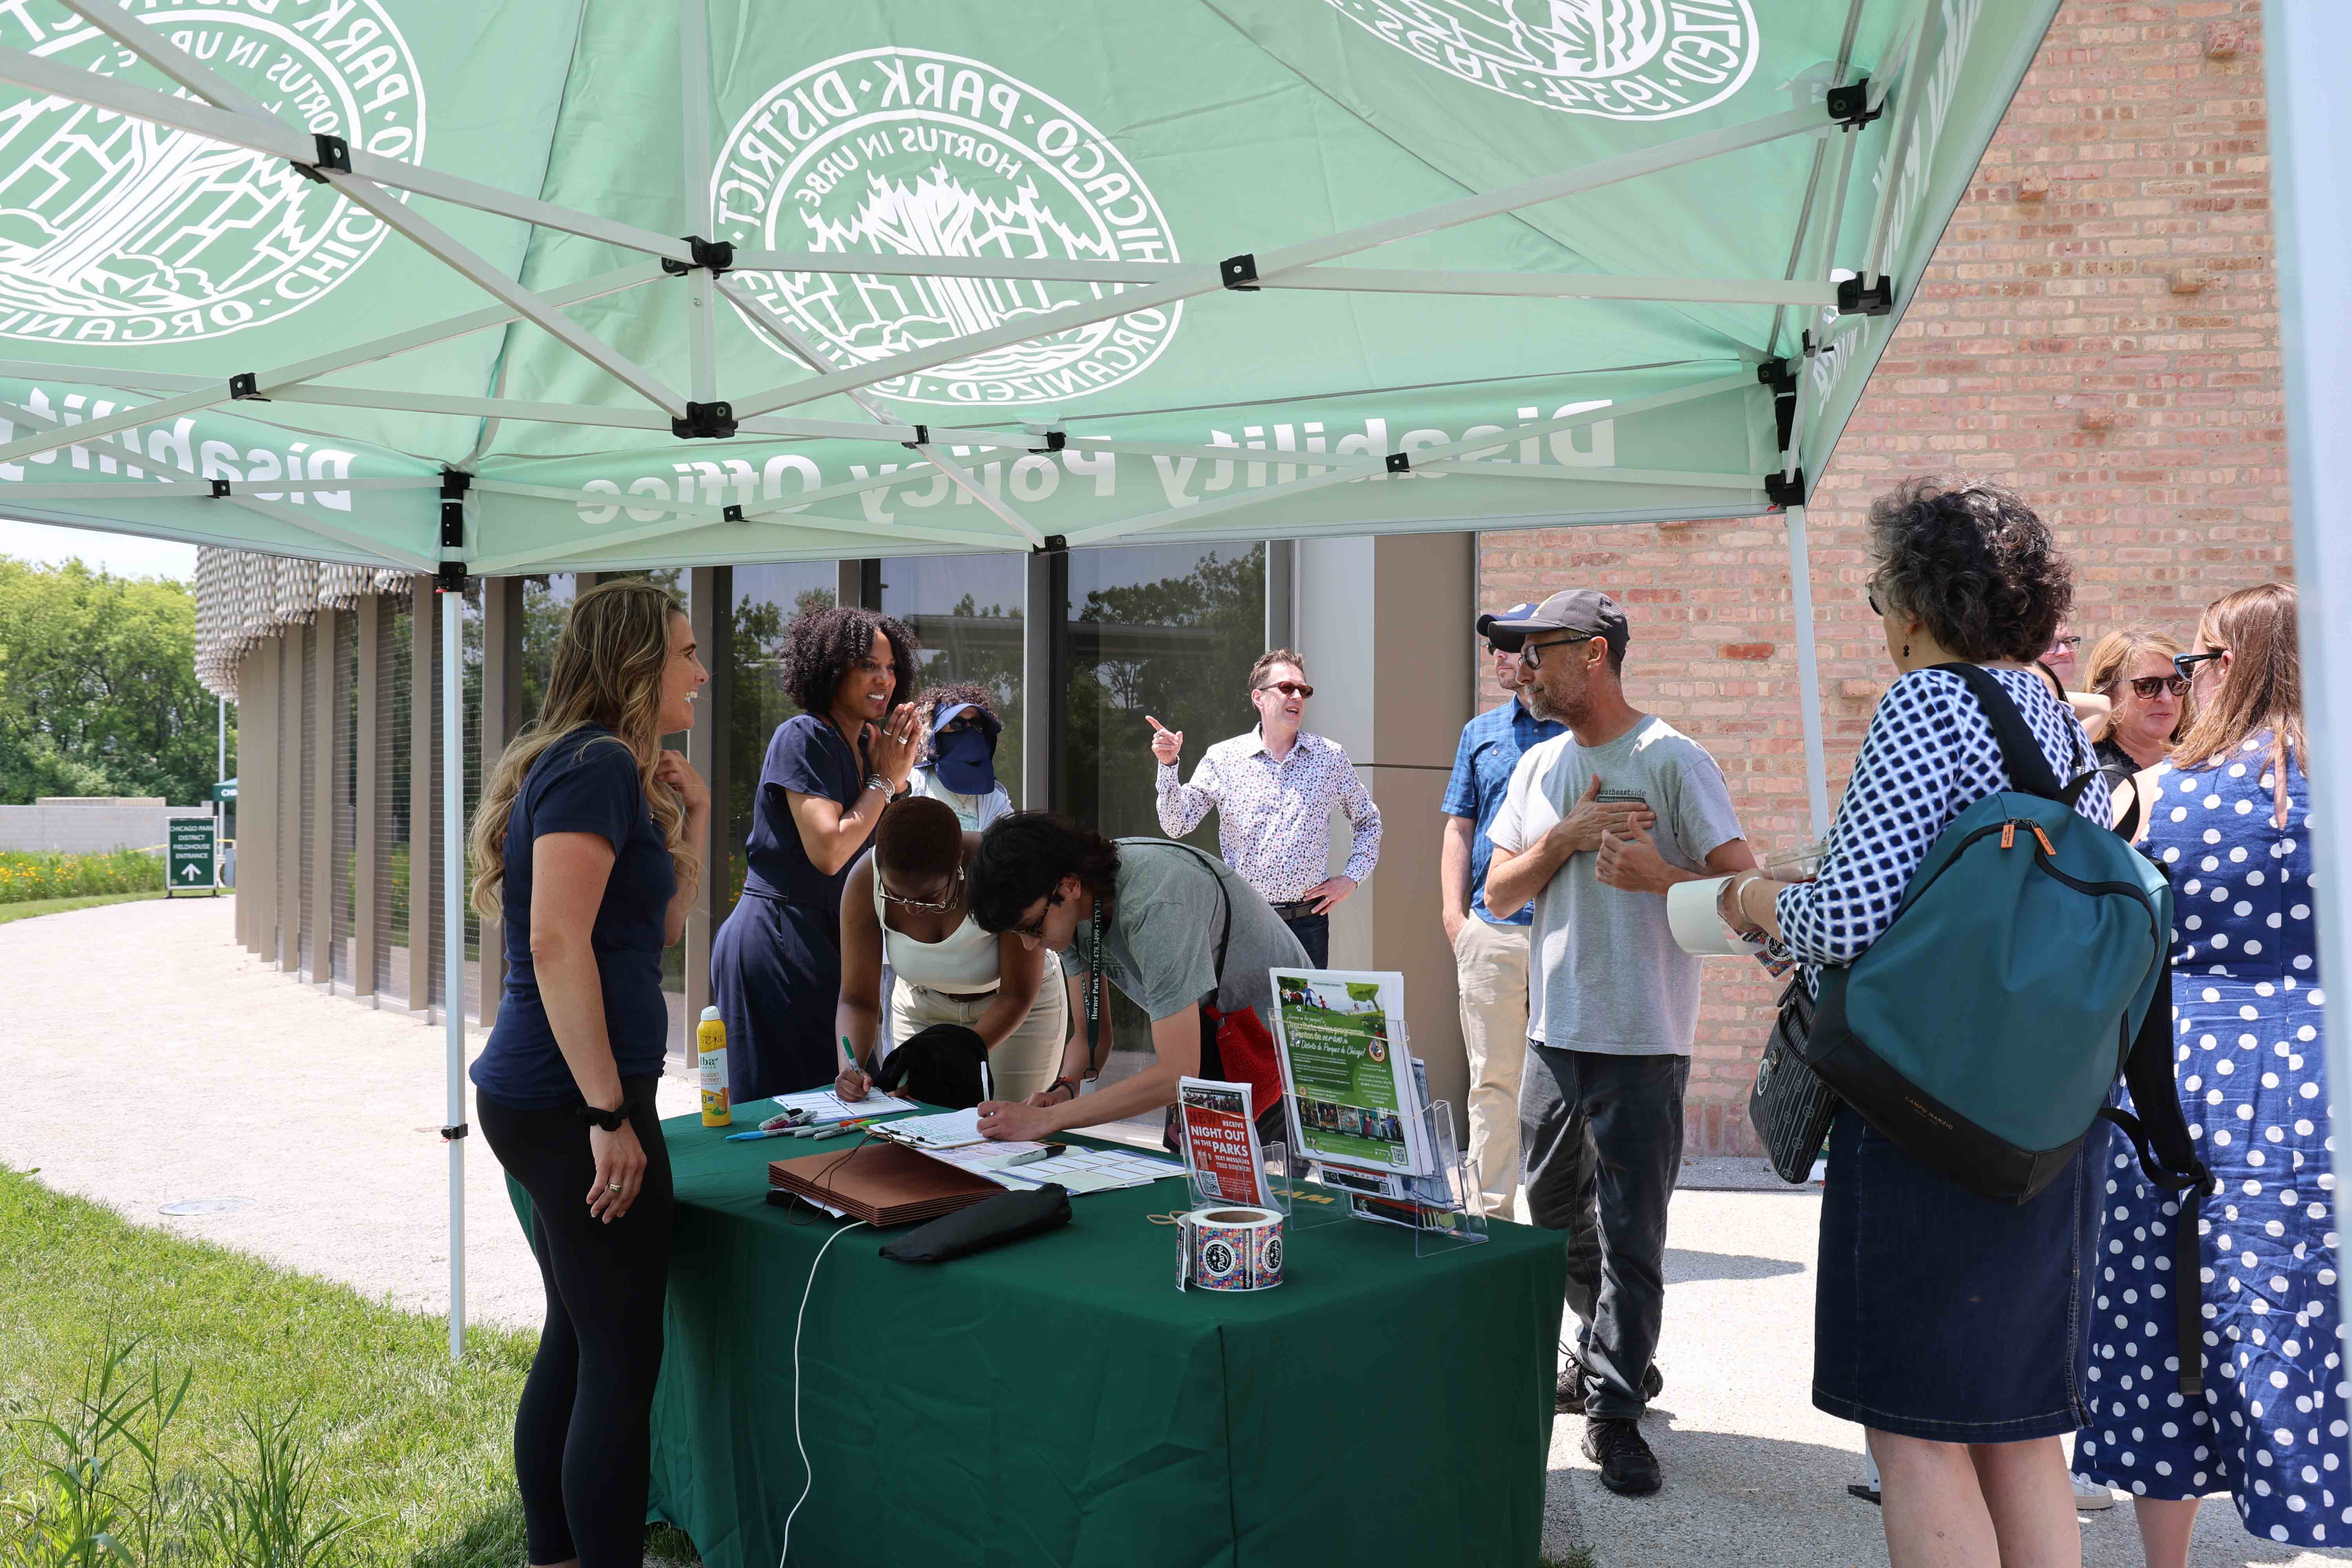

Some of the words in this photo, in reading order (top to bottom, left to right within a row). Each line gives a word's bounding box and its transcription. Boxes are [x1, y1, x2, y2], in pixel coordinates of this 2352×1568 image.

[1314, 1032, 1321, 1041] de
[700, 1057, 715, 1065] lba
[1222, 1120, 1243, 1129] RECEIVE
[1191, 1125, 1222, 1139] NIGHT
[1225, 1129, 1245, 1142] OUT
[1212, 1141, 1249, 1157] PARKS
